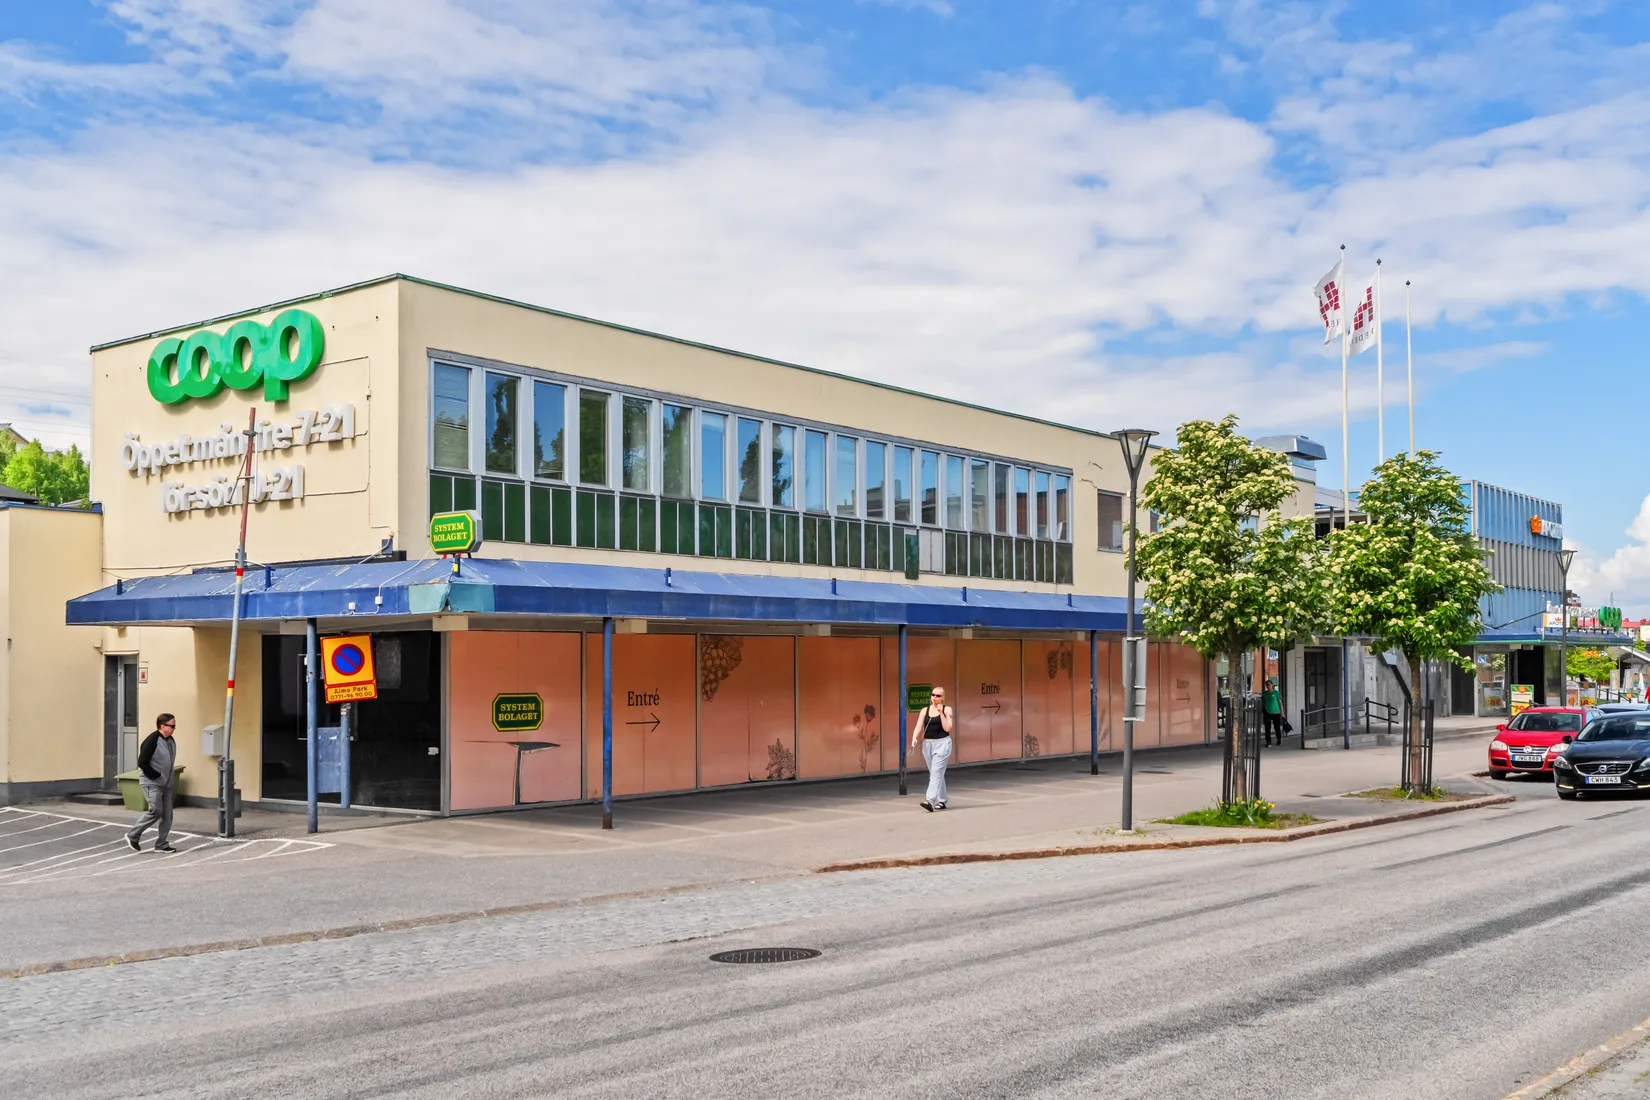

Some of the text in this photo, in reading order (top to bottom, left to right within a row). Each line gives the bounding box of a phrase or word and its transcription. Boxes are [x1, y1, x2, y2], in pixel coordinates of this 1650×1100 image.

[147, 309, 323, 403] coop
[121, 403, 355, 476] Öppet månfre 7-21
[434, 522, 465, 532] SYSTEM
[433, 532, 468, 542] BOLAGET
[981, 681, 1000, 695] Entré
[627, 688, 660, 706] Entré
[500, 703, 536, 712] SYSTEM
[498, 713, 539, 721] BOLAGET
